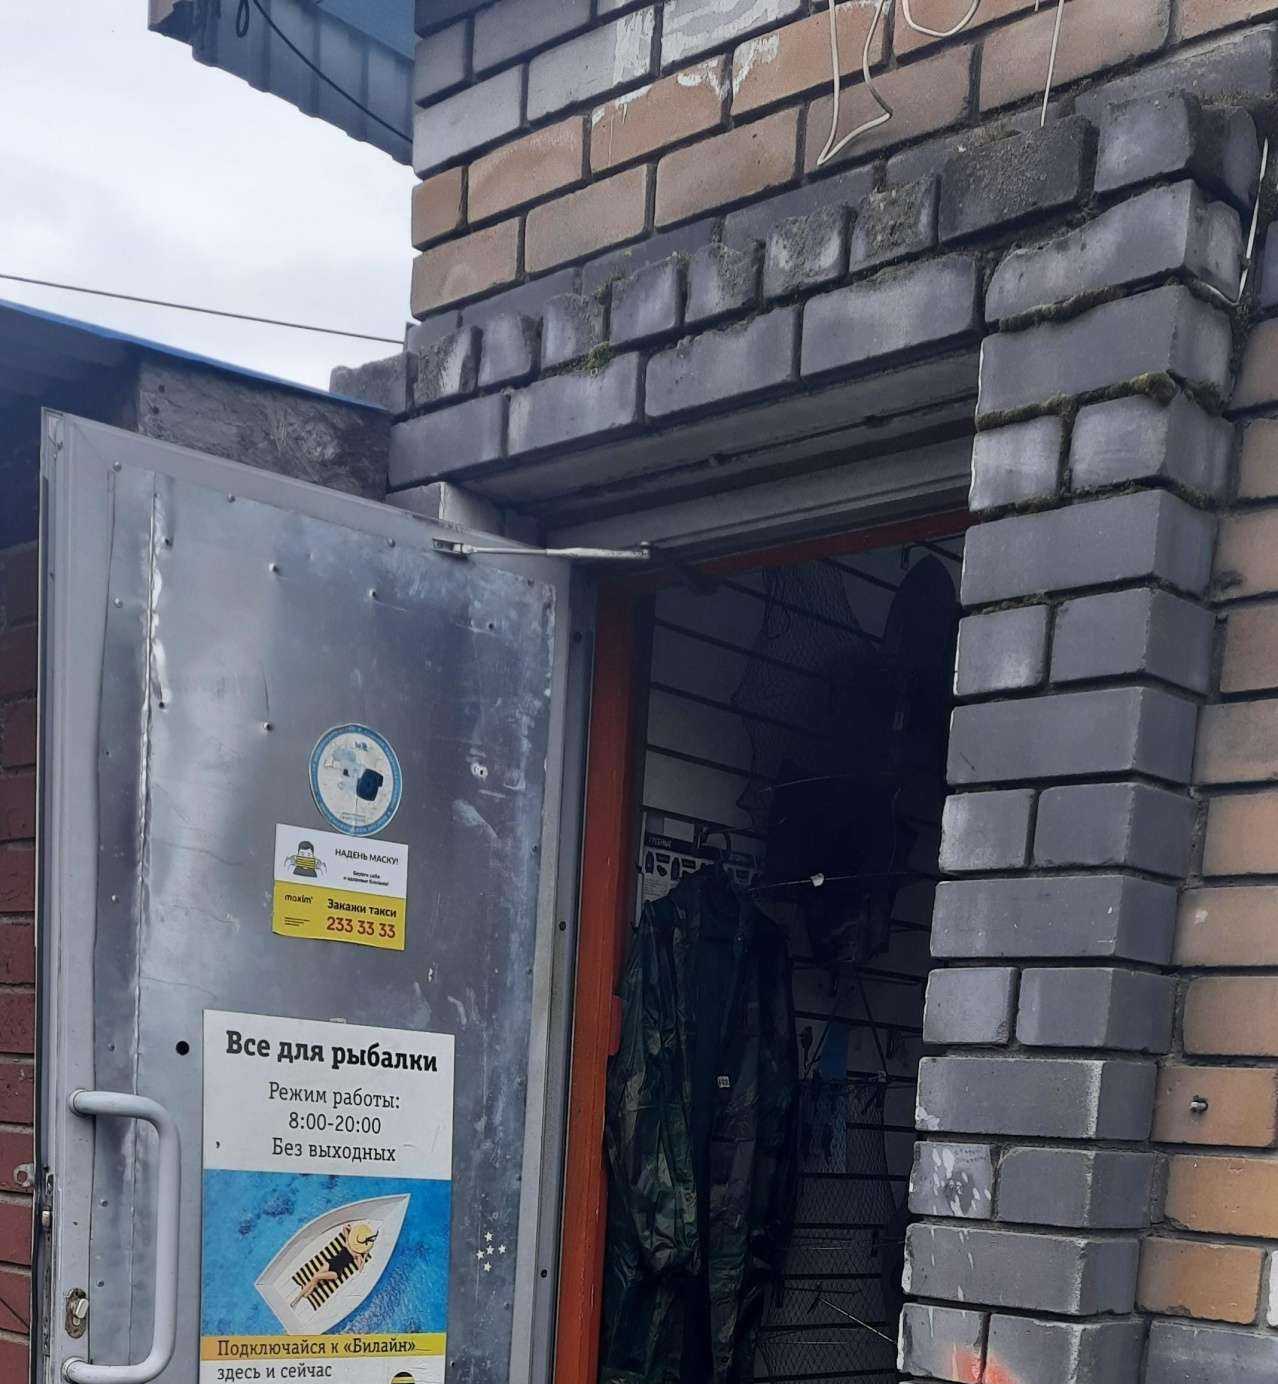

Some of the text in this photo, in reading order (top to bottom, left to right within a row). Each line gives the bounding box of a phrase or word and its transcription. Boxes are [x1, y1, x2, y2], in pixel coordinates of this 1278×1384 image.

[335, 848, 399, 865] НАДЕНЬ МАСКУ!
[327, 898, 397, 918] Закажи такси
[326, 916, 353, 933] 233
[357, 919, 375, 936] 33
[378, 922, 396, 938] 33
[225, 1030, 438, 1072] Все для рыбалки
[269, 1081, 400, 1109] Режим работы:
[288, 1111, 381, 1134] 8:00-20:00
[272, 1137, 396, 1163] Без выходных
[217, 1337, 416, 1358] Подключайся к «Билайн»
[217, 1363, 332, 1382] здесь и сейчас
